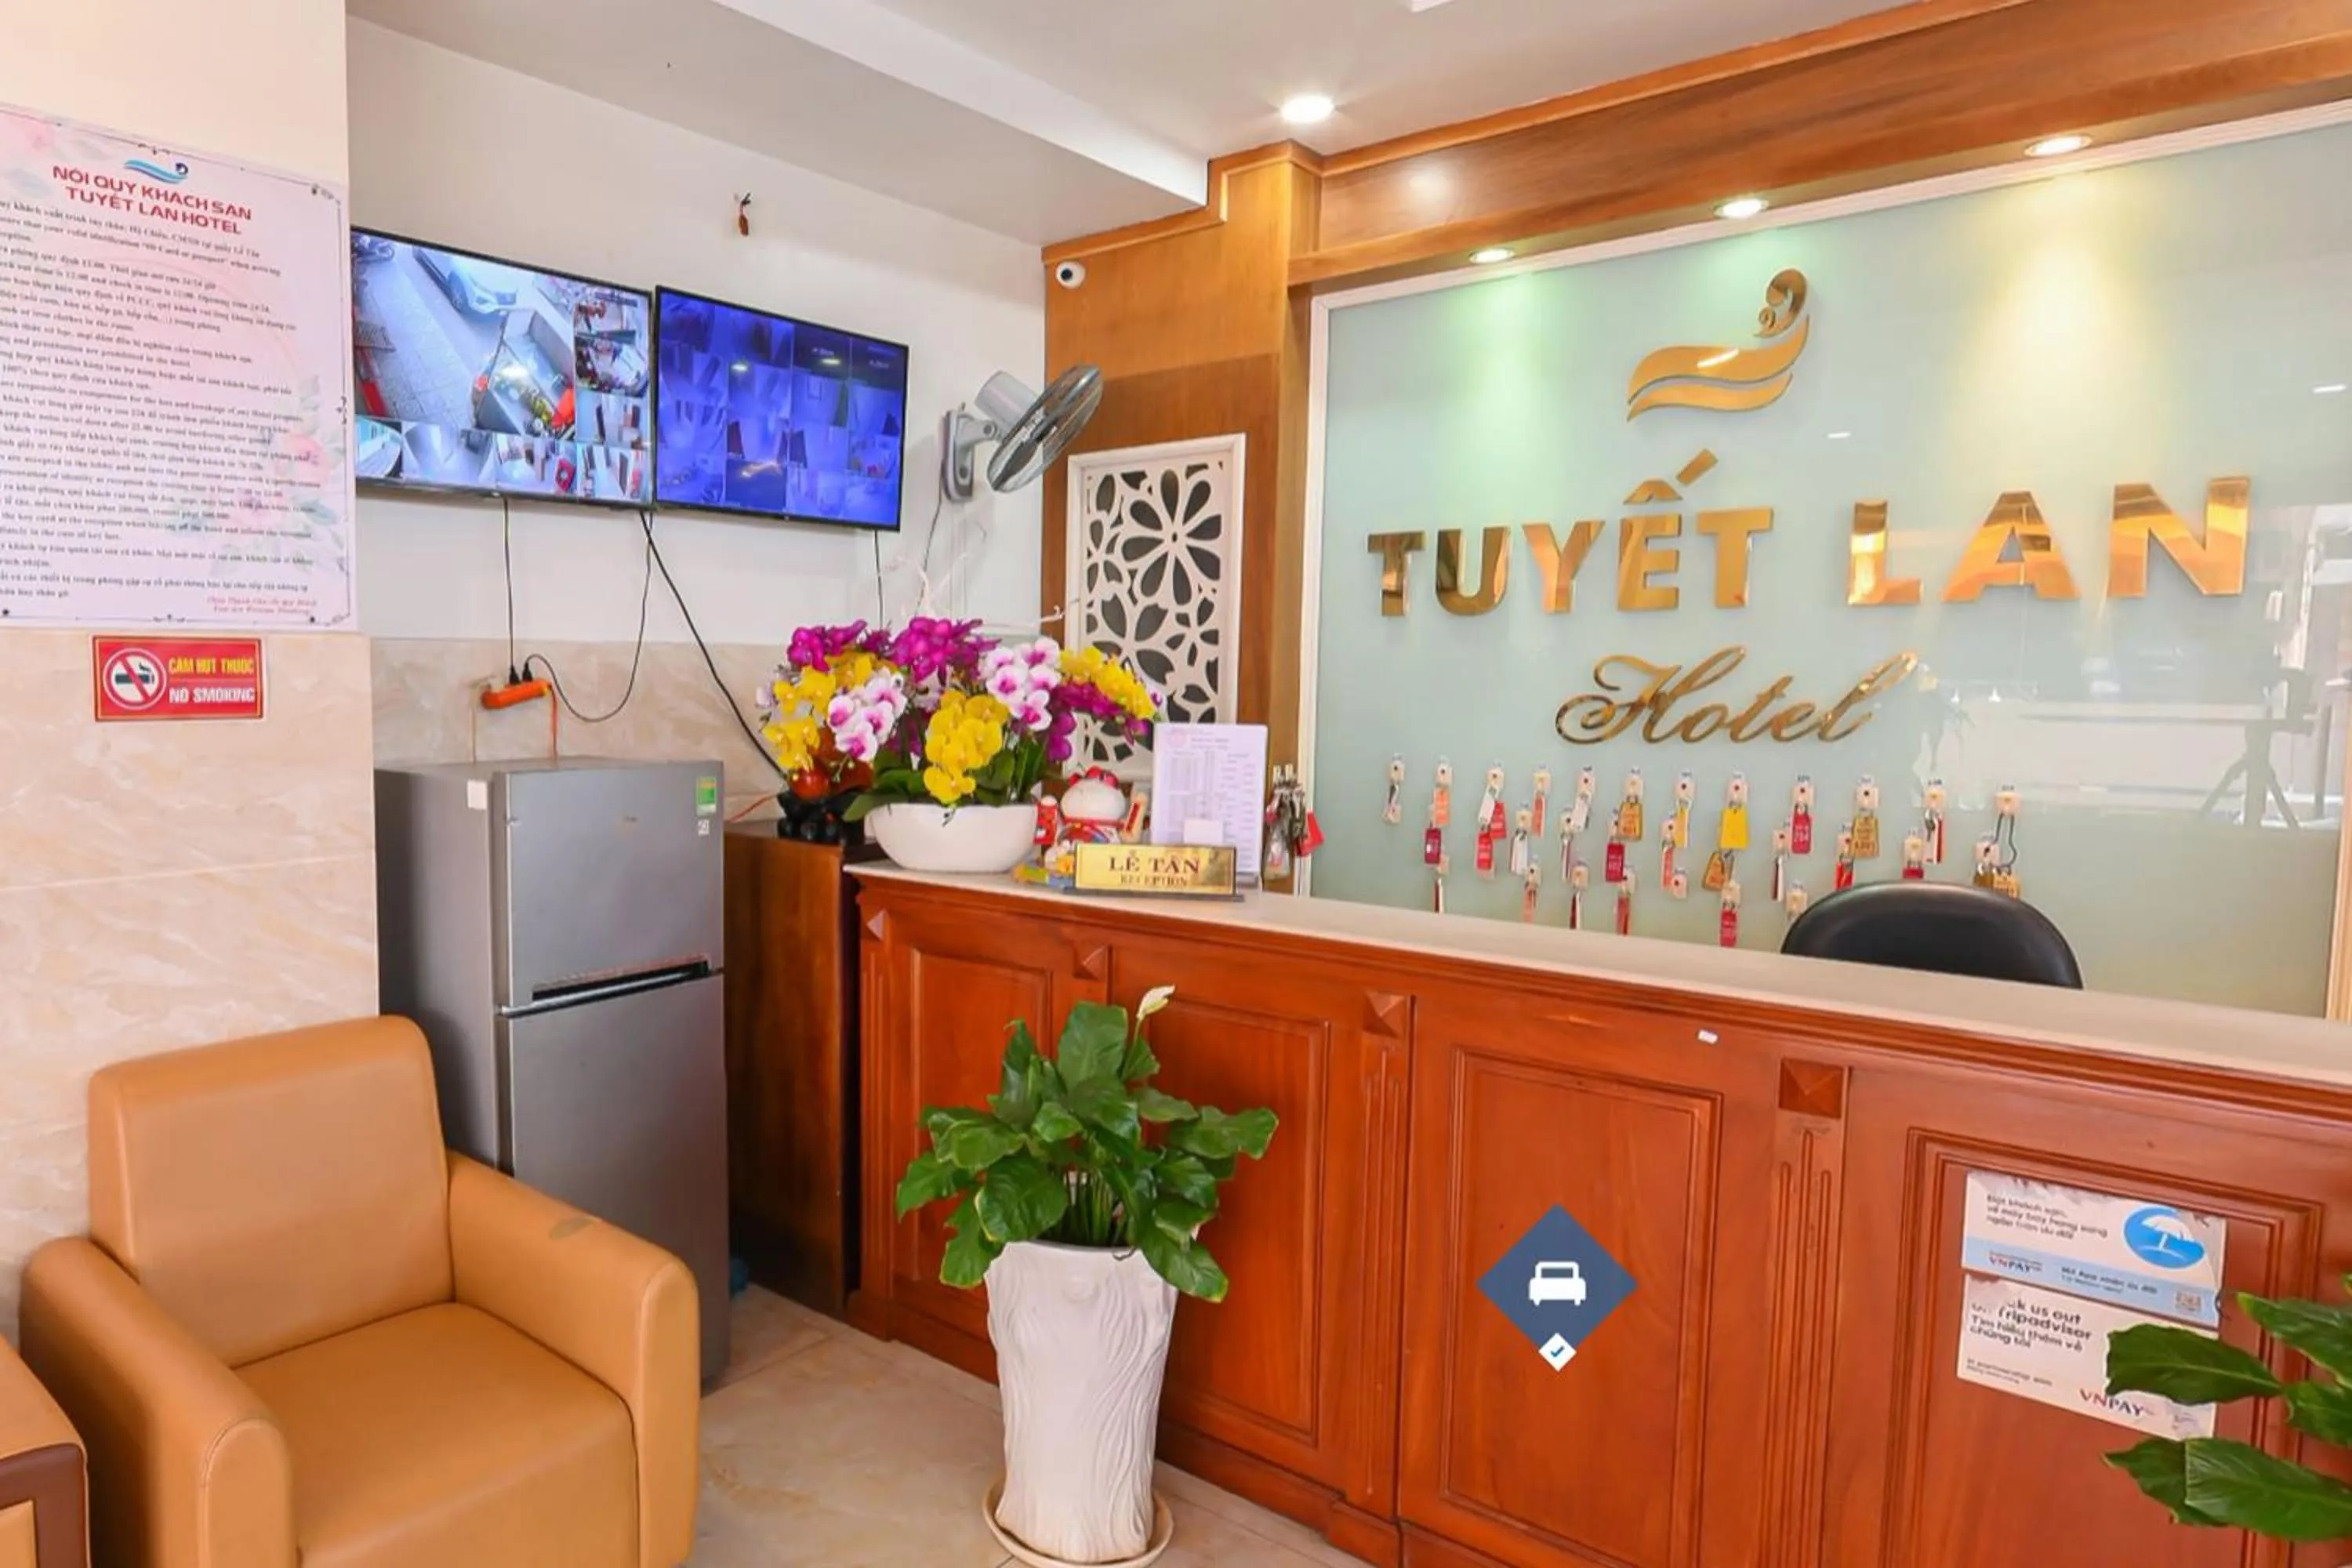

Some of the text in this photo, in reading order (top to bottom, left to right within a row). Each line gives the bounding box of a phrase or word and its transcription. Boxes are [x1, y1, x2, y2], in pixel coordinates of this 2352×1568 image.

[94, 174, 136, 194] QUY
[139, 201, 179, 222] LAN
[182, 208, 241, 234] HOTEL
[1367, 448, 2252, 617] TUYẾT LAN
[169, 687, 255, 704] NO SMOKING
[1555, 645, 1918, 744] Hotel
[1120, 873, 1187, 887] RECEPTION
[1989, 1255, 2031, 1272] VNPAY
[2031, 1304, 2049, 1317] us
[2053, 1310, 2082, 1324] out
[2079, 1388, 2144, 1417] VNPAY
